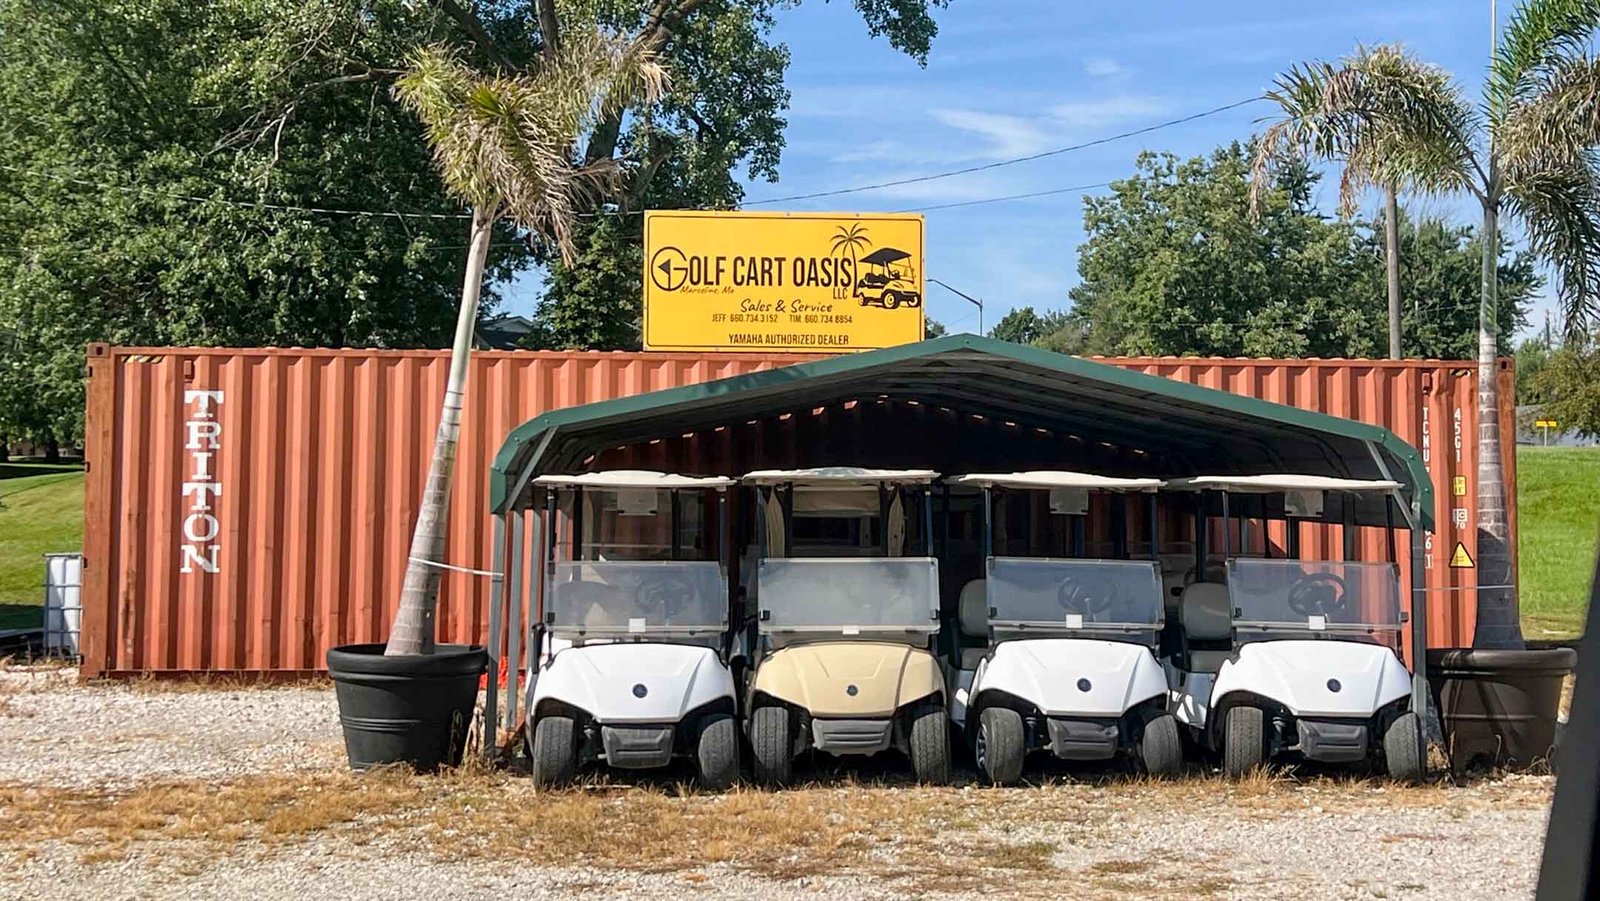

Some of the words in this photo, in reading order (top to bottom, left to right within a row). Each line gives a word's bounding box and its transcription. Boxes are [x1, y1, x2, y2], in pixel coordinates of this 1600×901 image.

[651, 247, 726, 291] GOLF
[733, 256, 786, 286] CART
[793, 257, 852, 287] OASIS
[721, 286, 734, 294] Mo
[833, 288, 848, 299] LLC
[741, 298, 772, 313] Sales
[775, 299, 786, 312] &
[791, 299, 833, 313] Service
[729, 334, 763, 344] YAMAHA
[765, 334, 816, 345] AUTHORIZED
[818, 334, 849, 345] DEALER
[180, 390, 224, 573] TRITON
